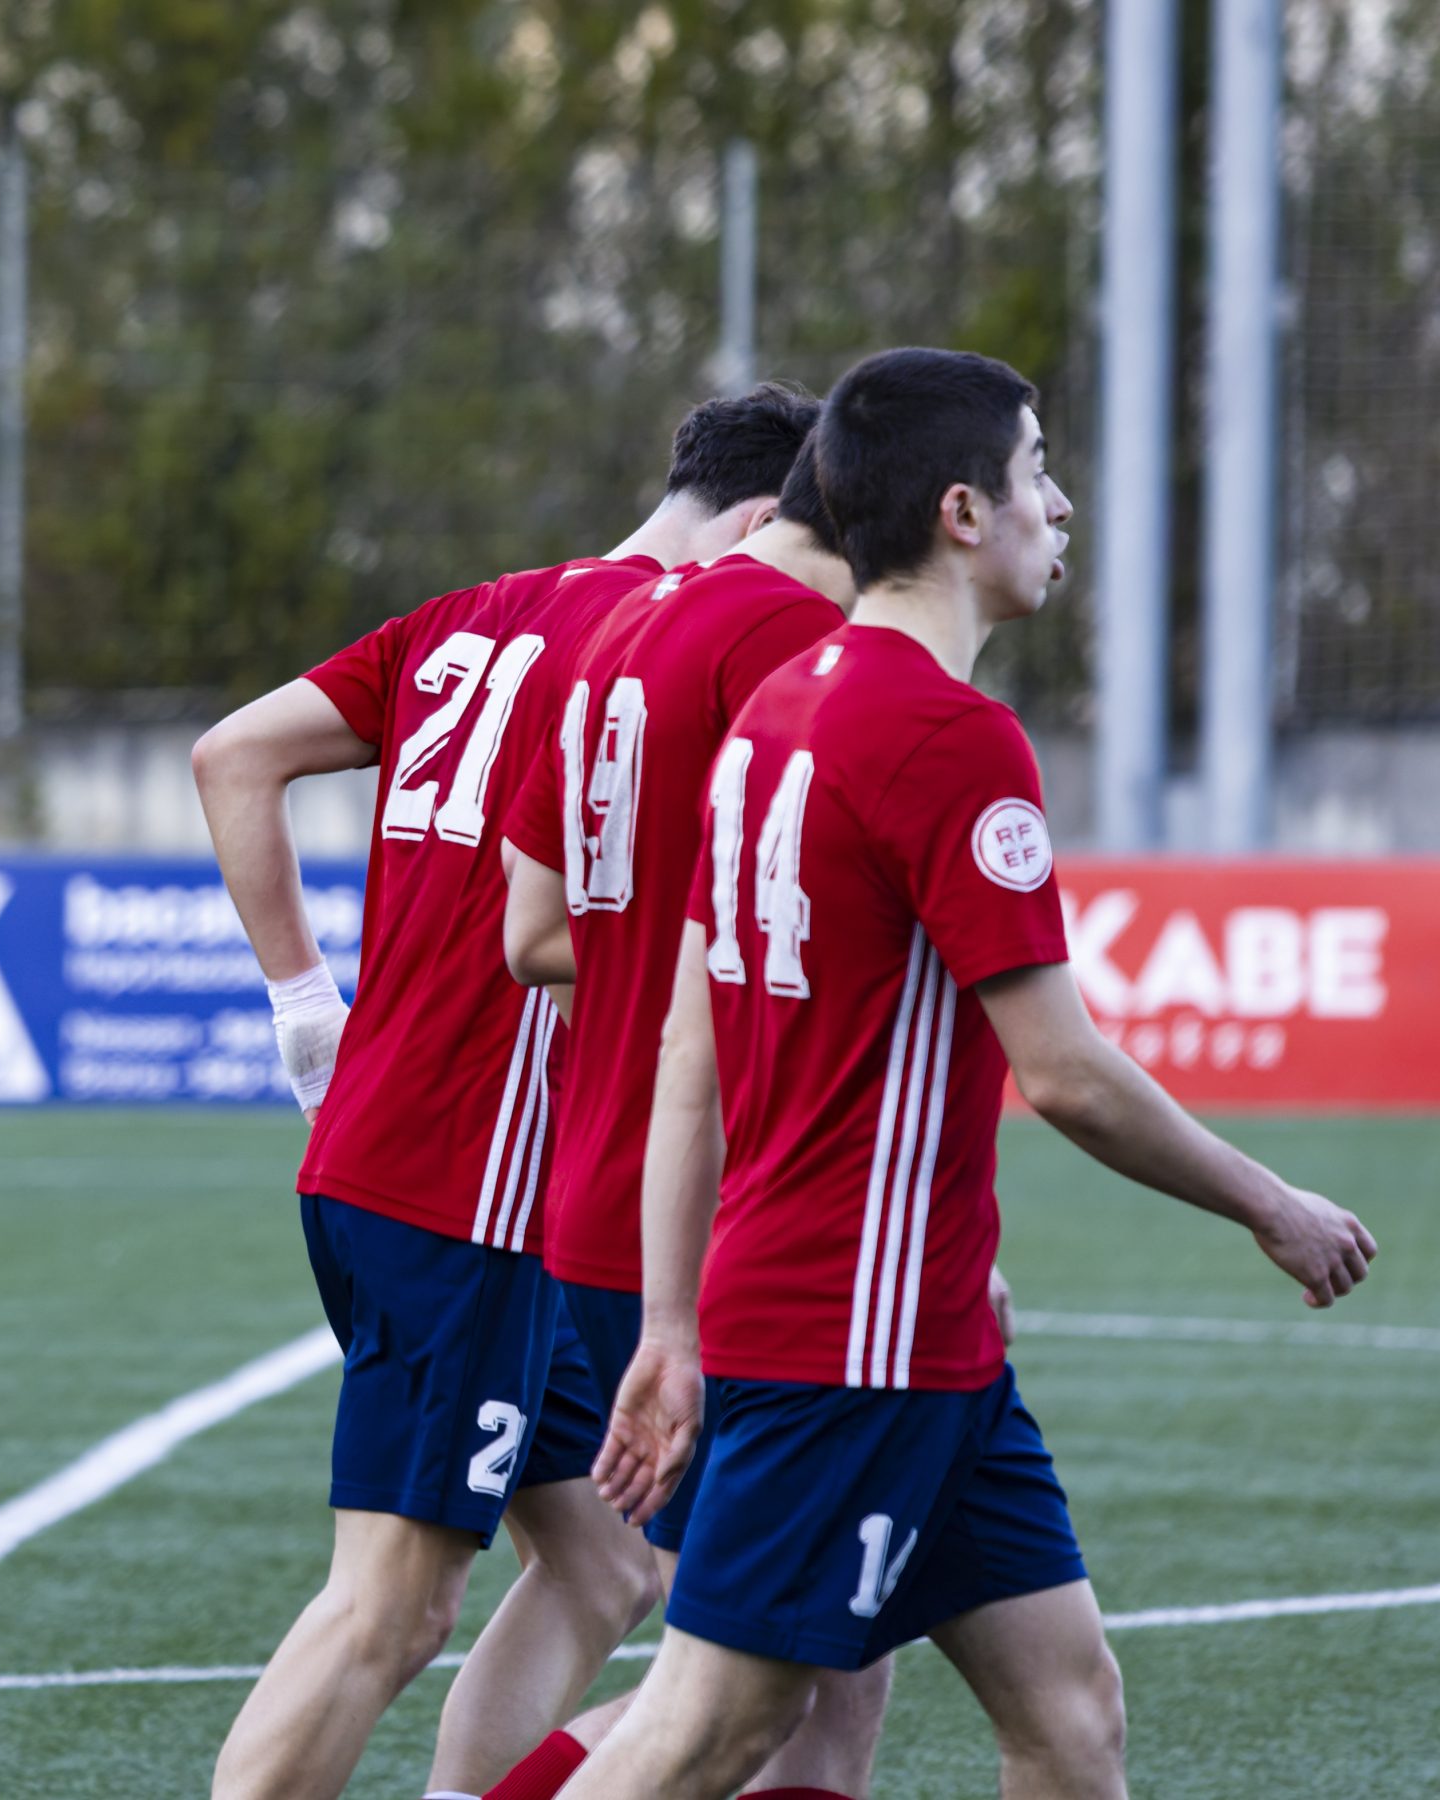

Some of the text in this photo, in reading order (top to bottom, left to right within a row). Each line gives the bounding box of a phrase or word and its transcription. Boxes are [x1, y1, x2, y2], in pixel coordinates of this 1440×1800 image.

[381, 632, 545, 847] 21
[560, 677, 648, 916] 19
[707, 737, 815, 999] 14
